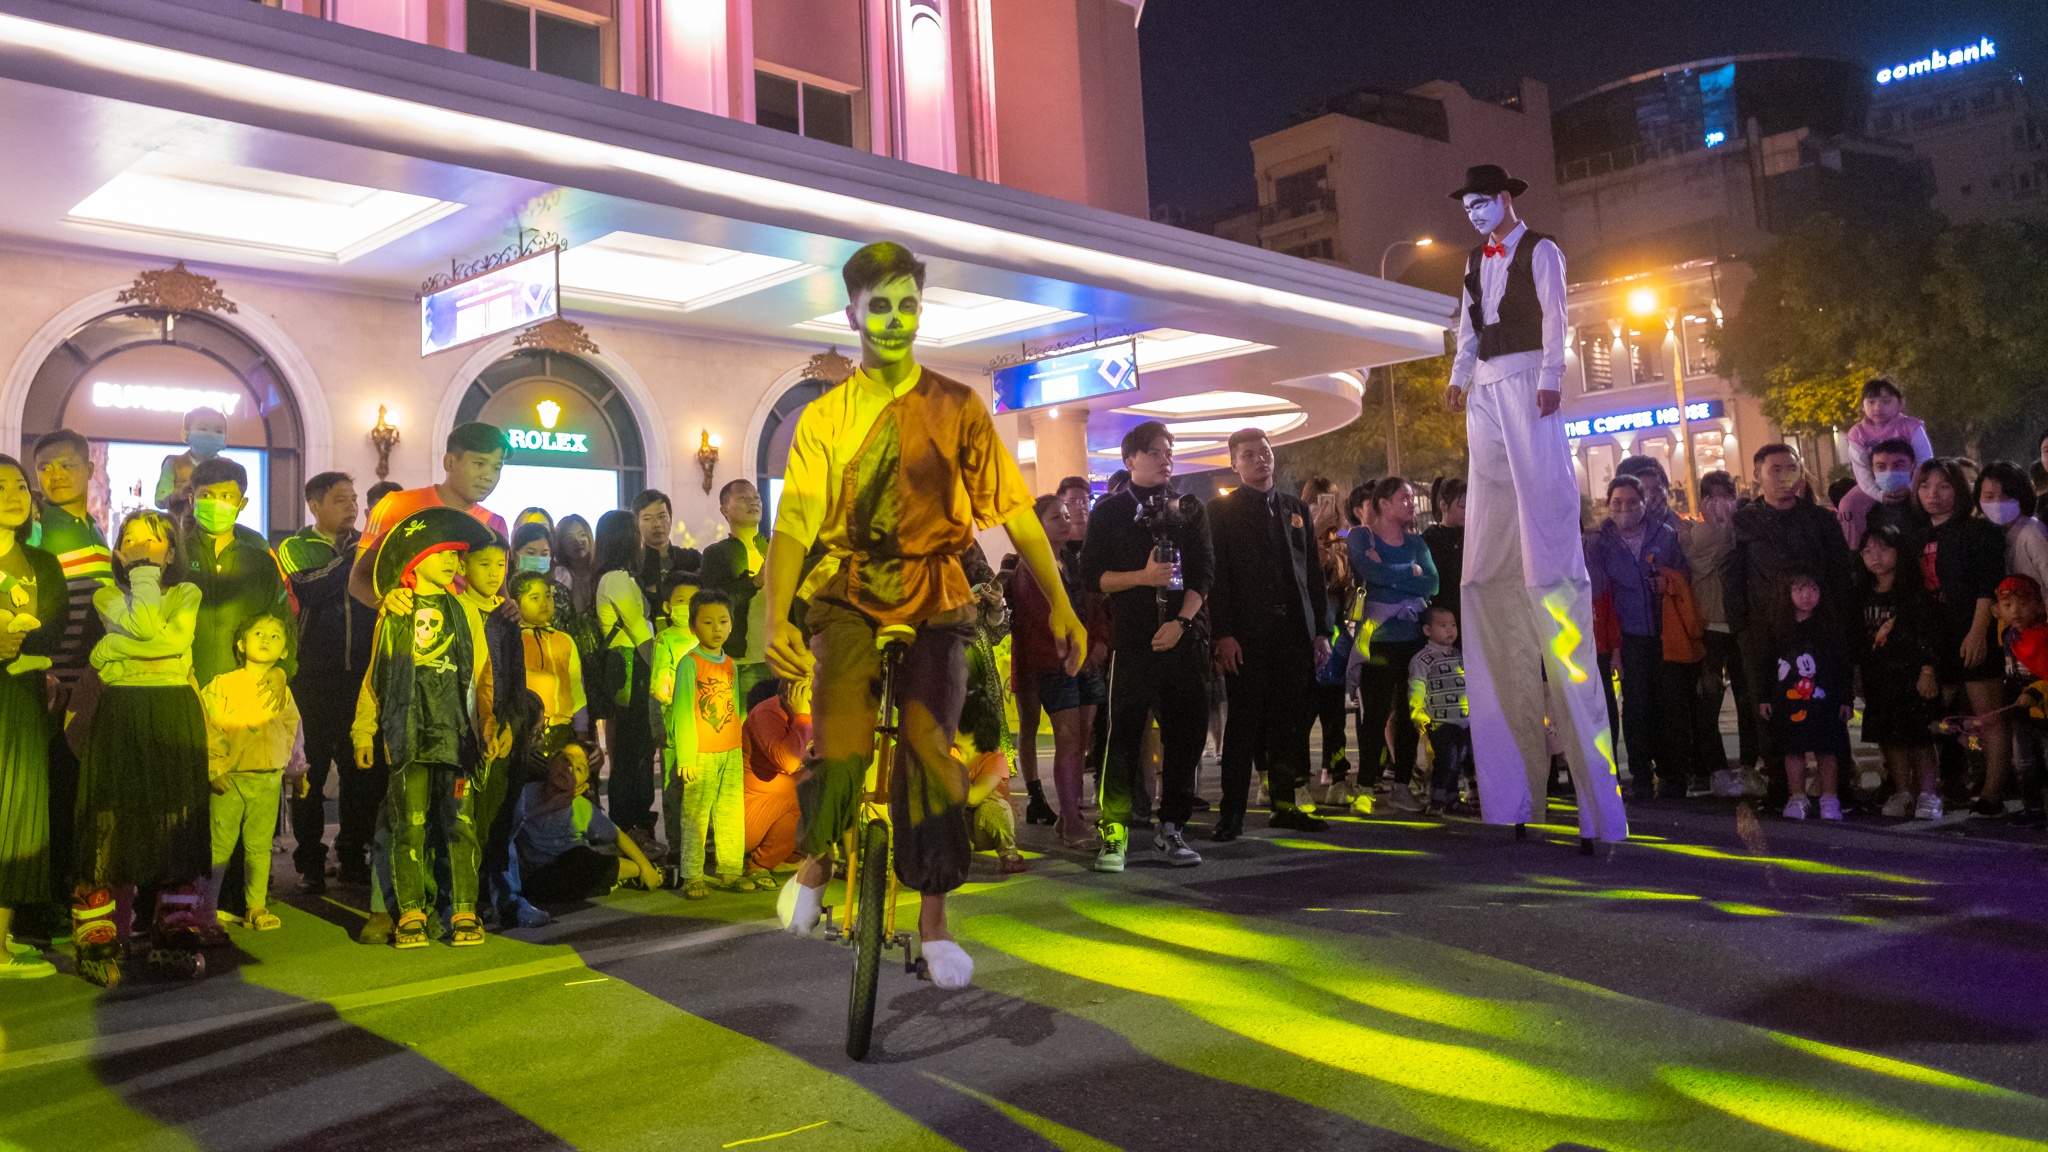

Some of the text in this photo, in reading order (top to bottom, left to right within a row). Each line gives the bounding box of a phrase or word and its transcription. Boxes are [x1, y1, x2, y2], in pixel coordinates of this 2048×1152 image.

[1876, 36, 1996, 84] combank
[1564, 420, 1591, 437] THE
[1593, 411, 1654, 433] COFFEE
[508, 428, 588, 452] ROLEX
